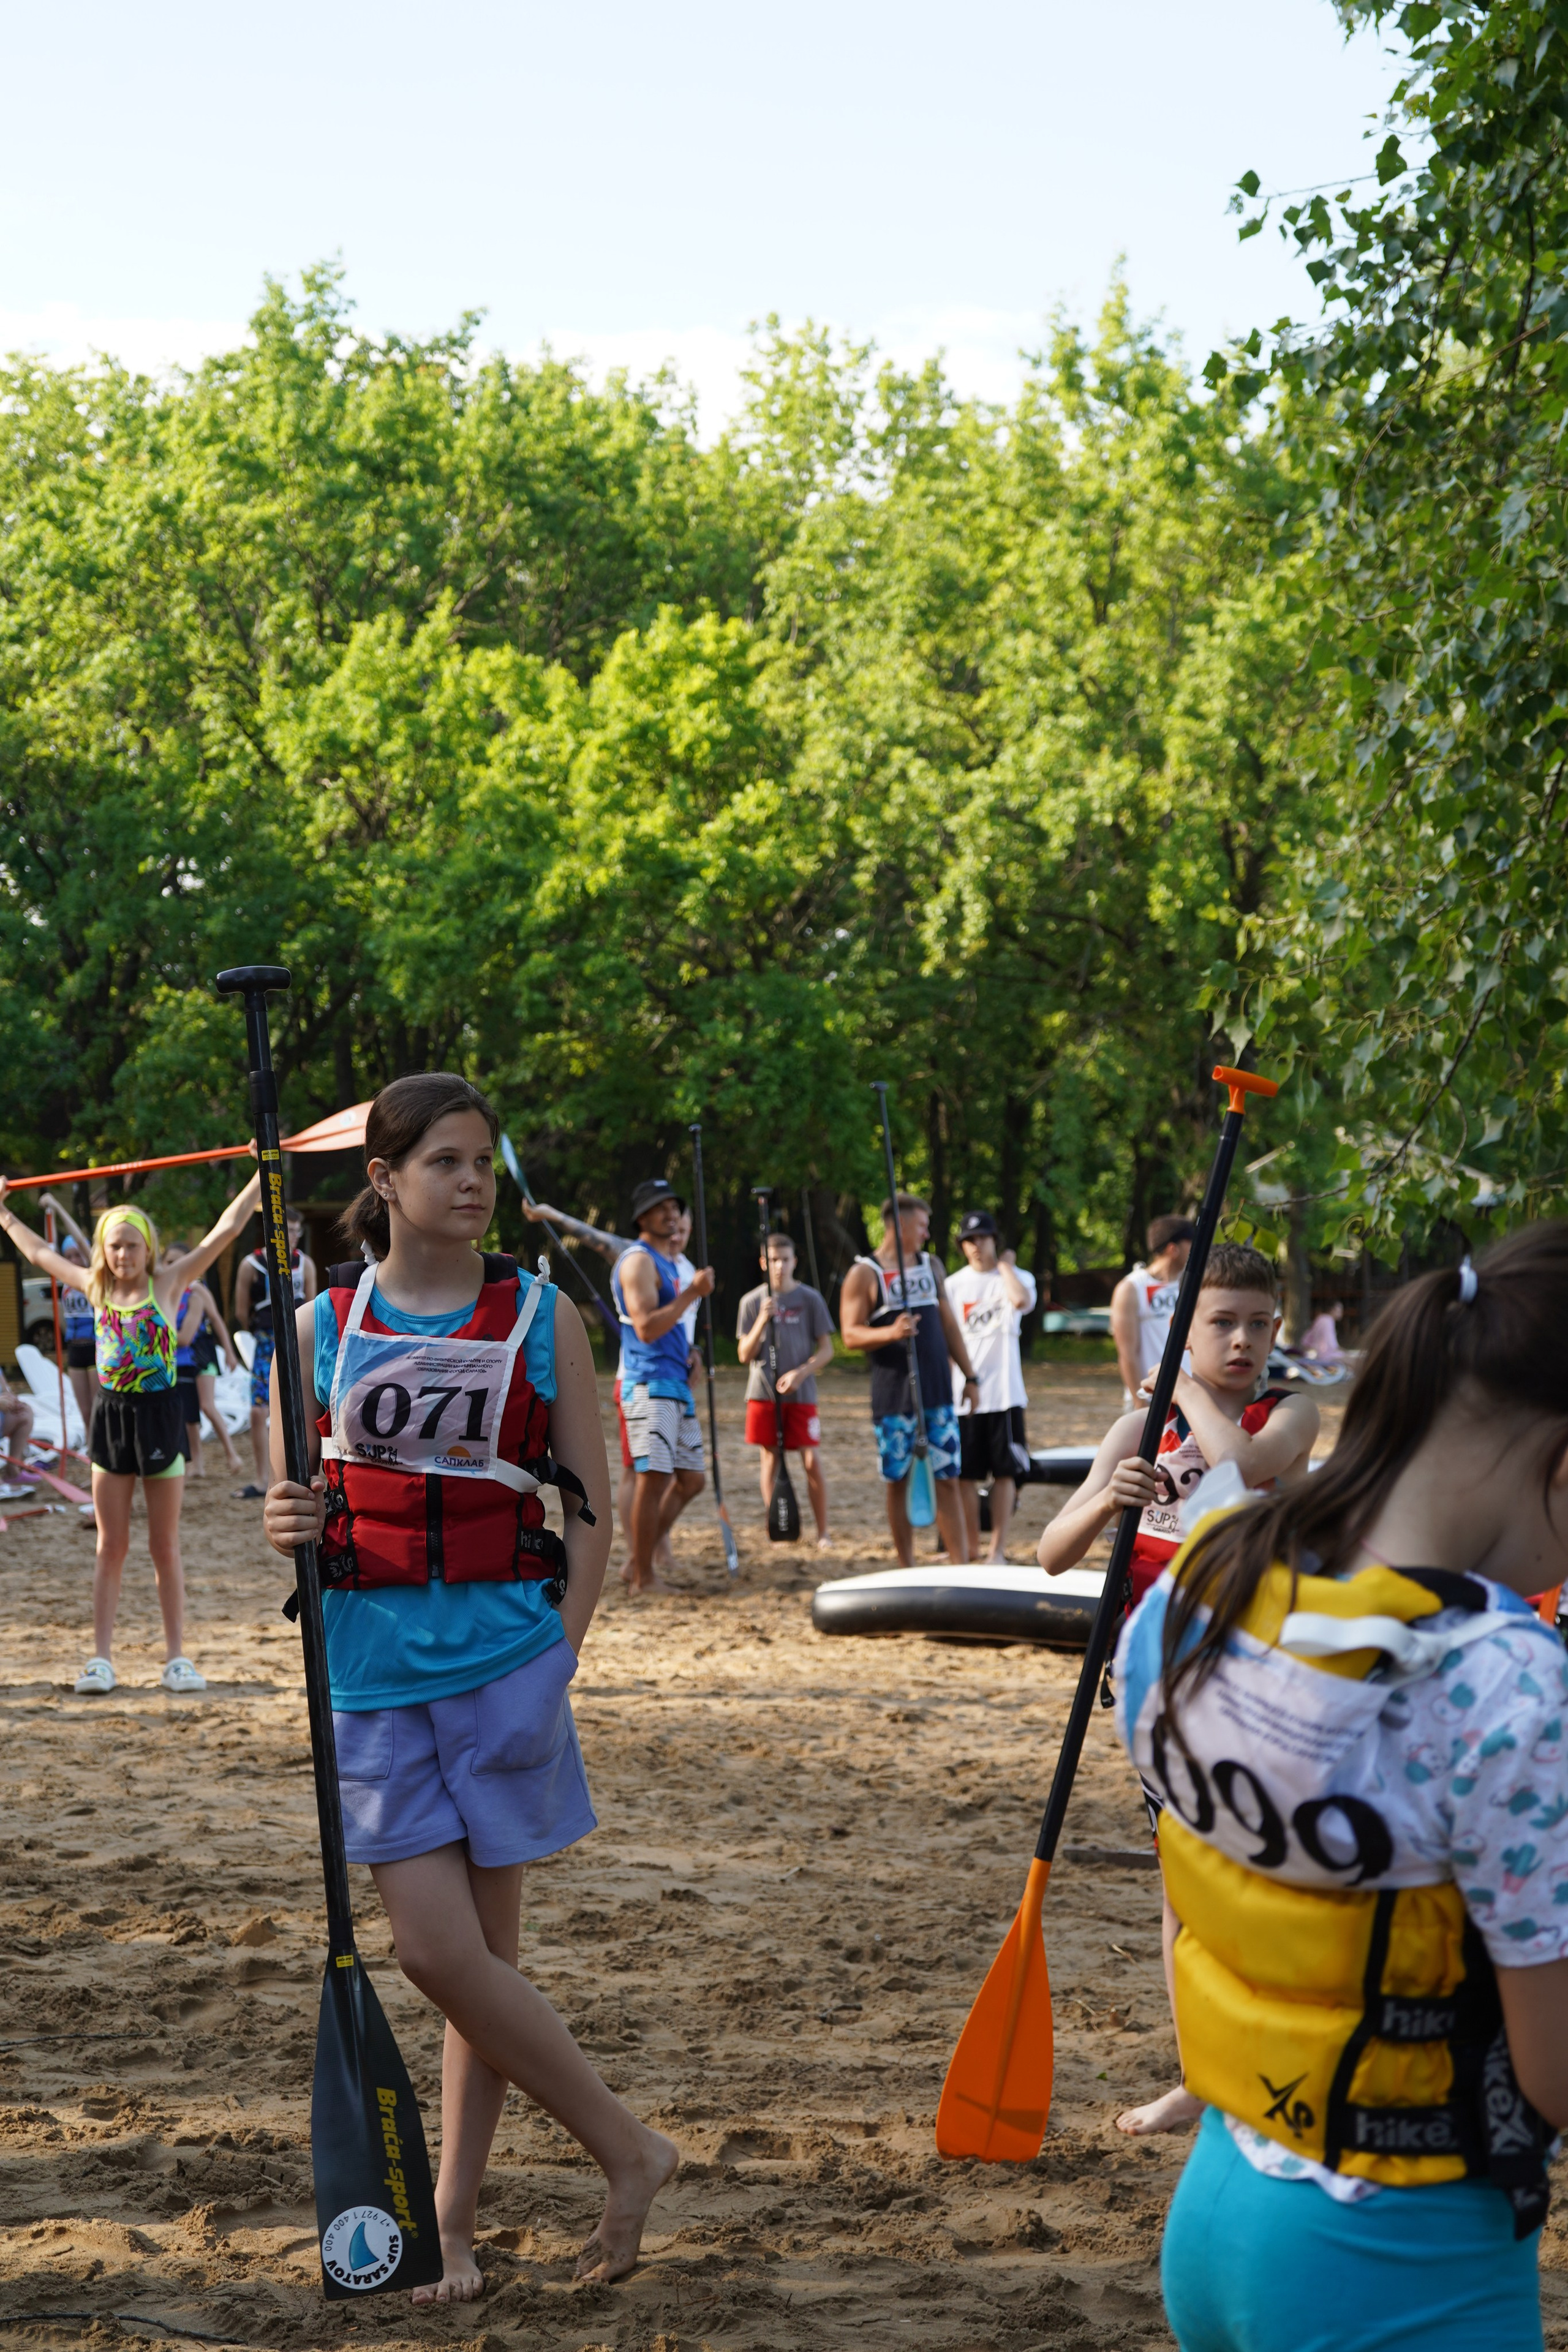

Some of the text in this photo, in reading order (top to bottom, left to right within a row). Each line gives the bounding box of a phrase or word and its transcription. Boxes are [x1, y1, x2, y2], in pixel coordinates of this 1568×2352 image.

[361, 1382, 489, 1441] 071
[434, 1456, 484, 1468] САПКЛАБ
[1152, 1713, 1394, 1887] 099
[1355, 2112, 1459, 2147] hike
[333, 2215, 350, 2231] 400
[361, 2211, 379, 2221] 927
[380, 2218, 391, 2228] +7
[324, 2233, 335, 2252] 400
[326, 2234, 399, 2285] SUP SARATOV
